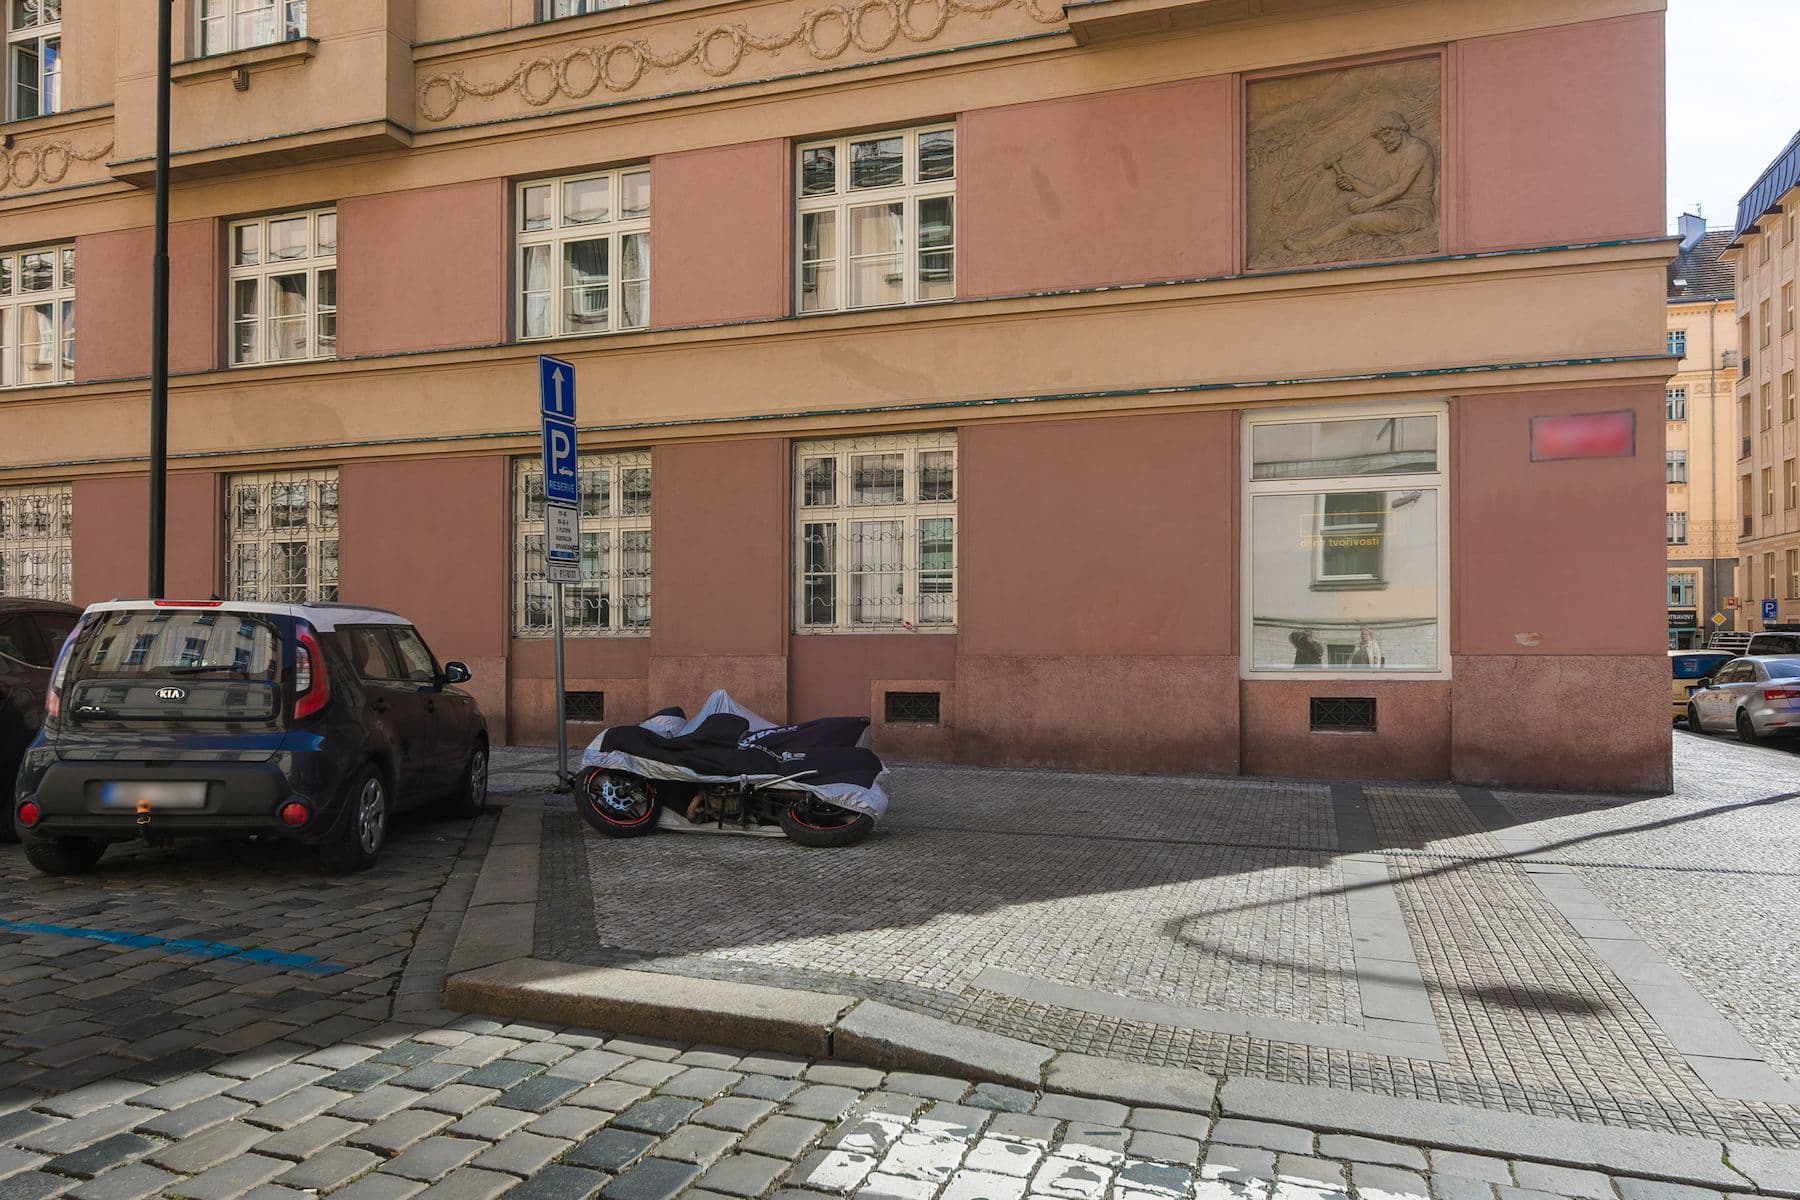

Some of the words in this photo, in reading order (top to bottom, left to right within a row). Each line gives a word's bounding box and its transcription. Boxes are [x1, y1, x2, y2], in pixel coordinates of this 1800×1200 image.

[551, 429, 570, 475] P
[1765, 602, 1775, 614] P
[159, 689, 180, 699] KIA
